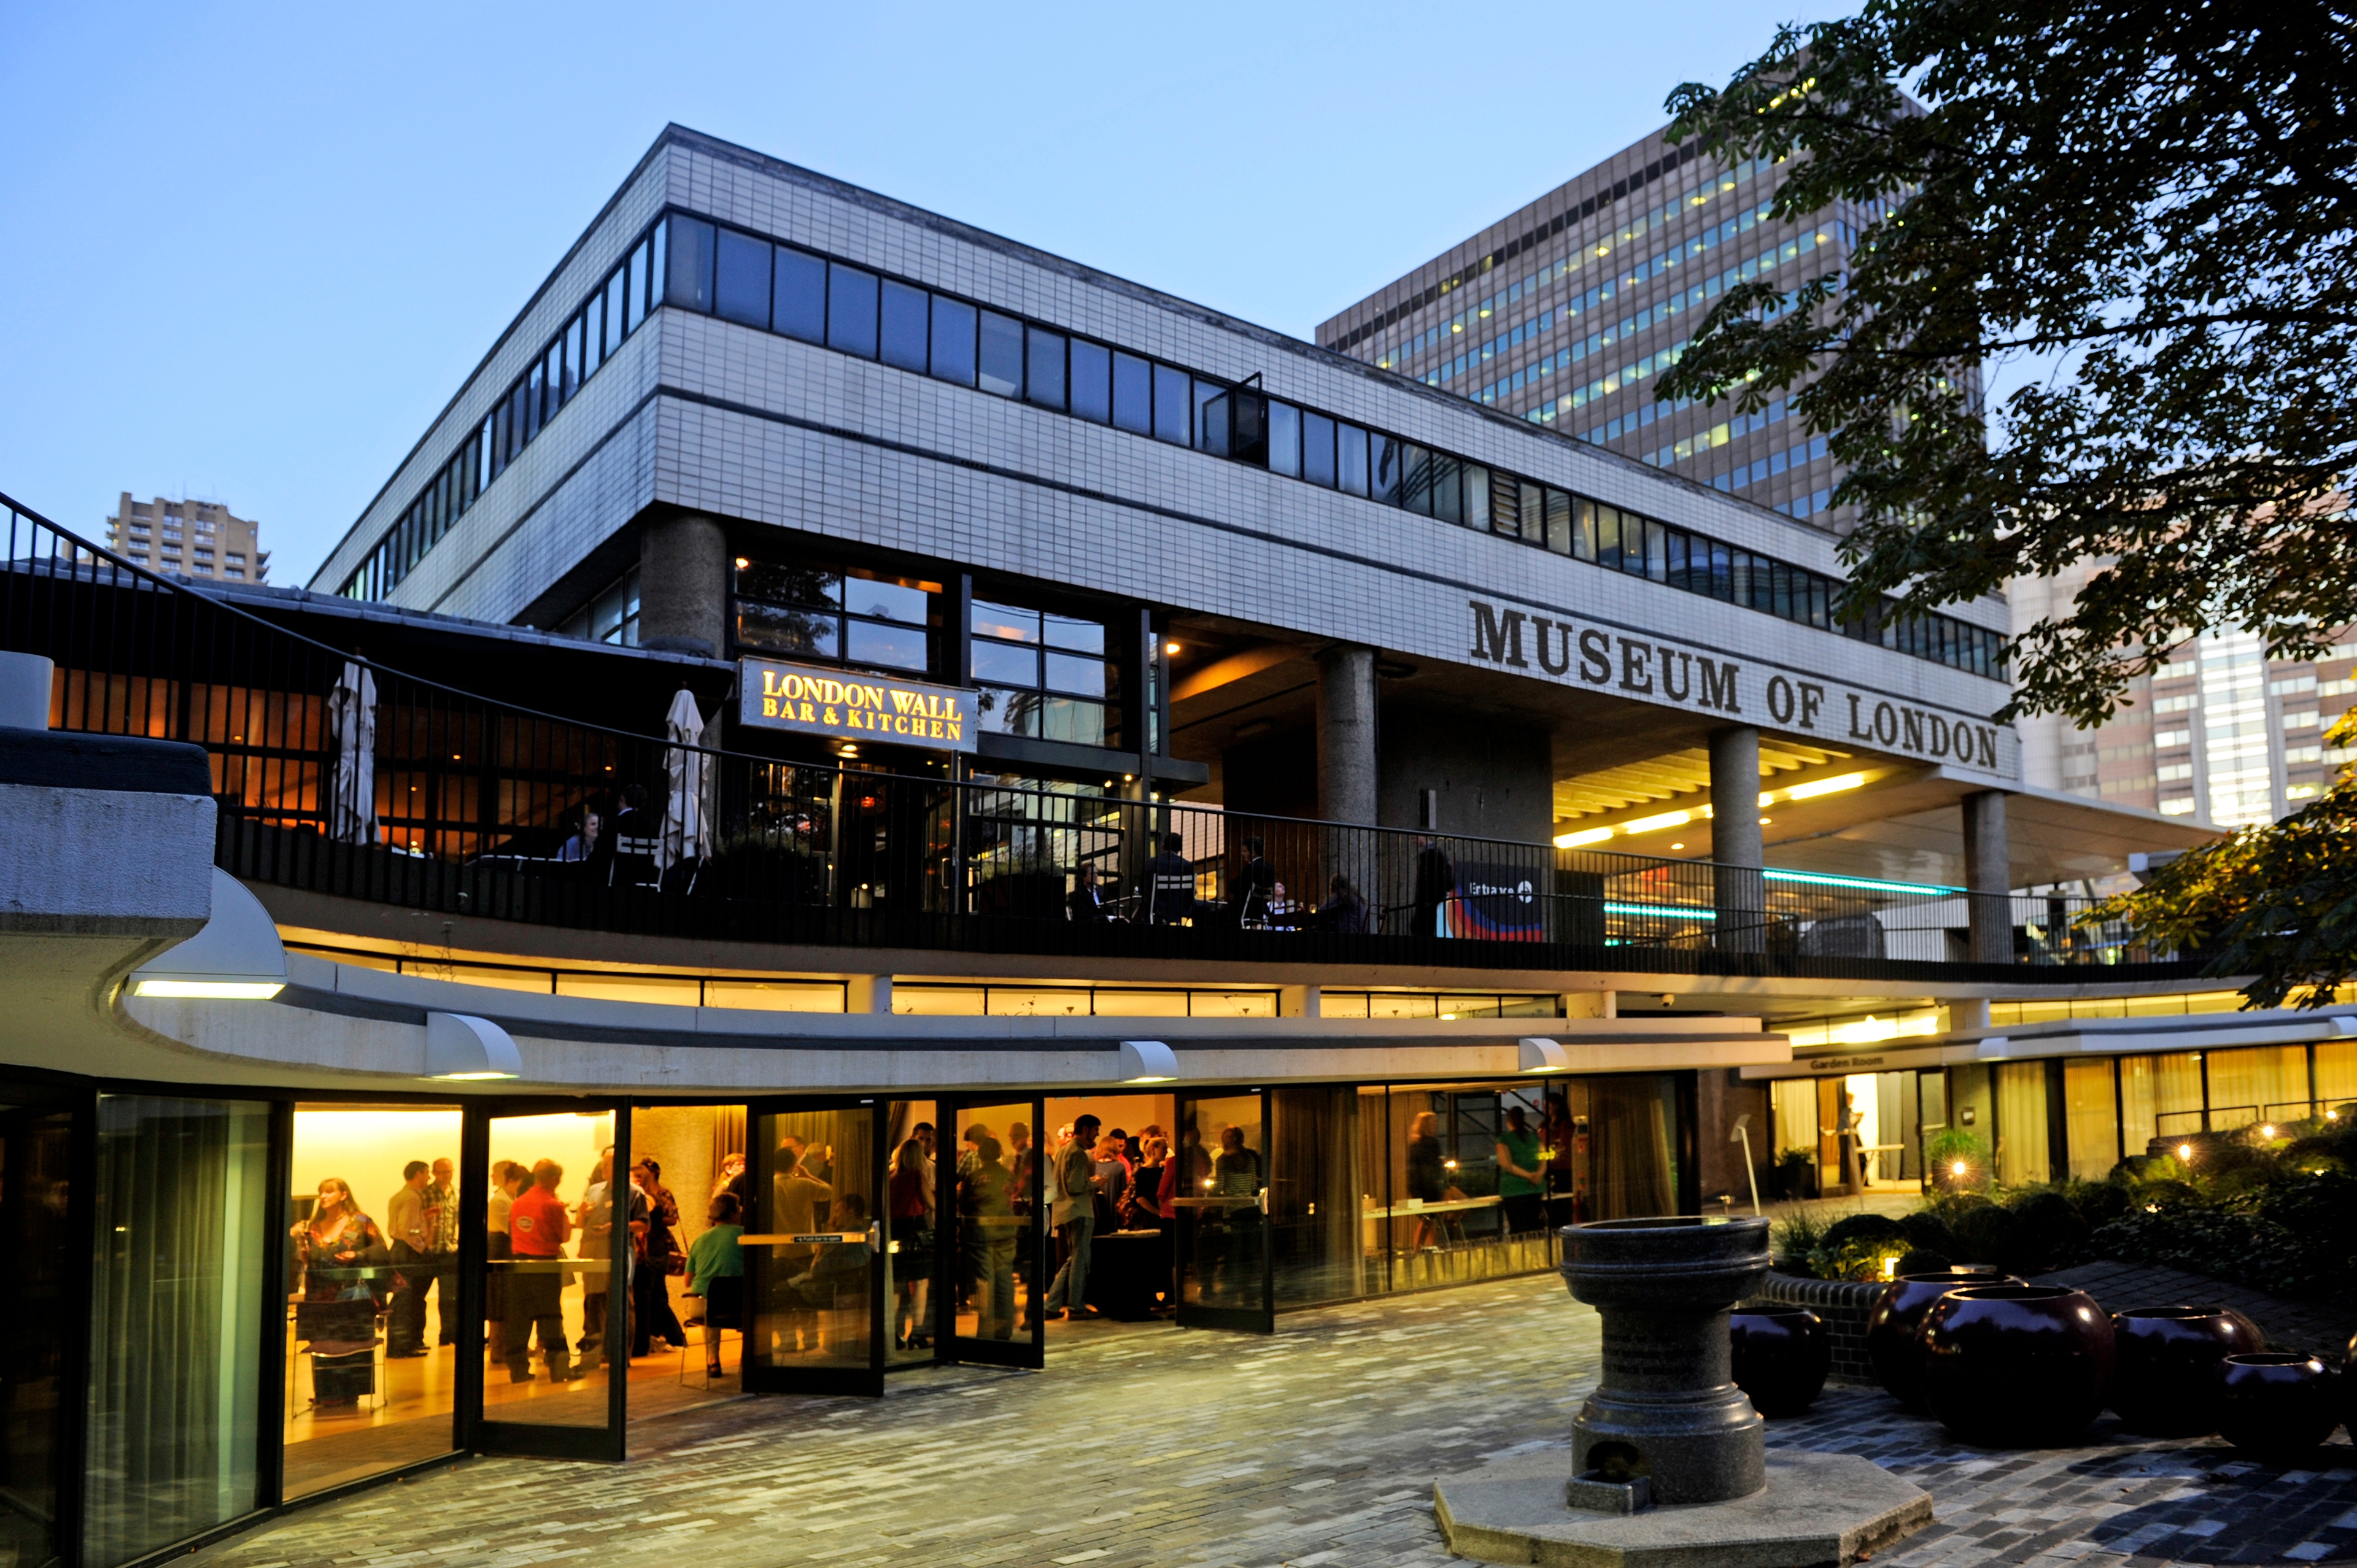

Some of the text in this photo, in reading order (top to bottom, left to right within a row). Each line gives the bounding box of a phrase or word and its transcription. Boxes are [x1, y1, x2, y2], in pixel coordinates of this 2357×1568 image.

[763, 670, 962, 721] LONDON WALL
[1469, 600, 1997, 768] MUSEUM OF LONDON
[762, 698, 961, 741] BAR & KITCHEN
[1811, 1057, 1883, 1070] Garden Room
